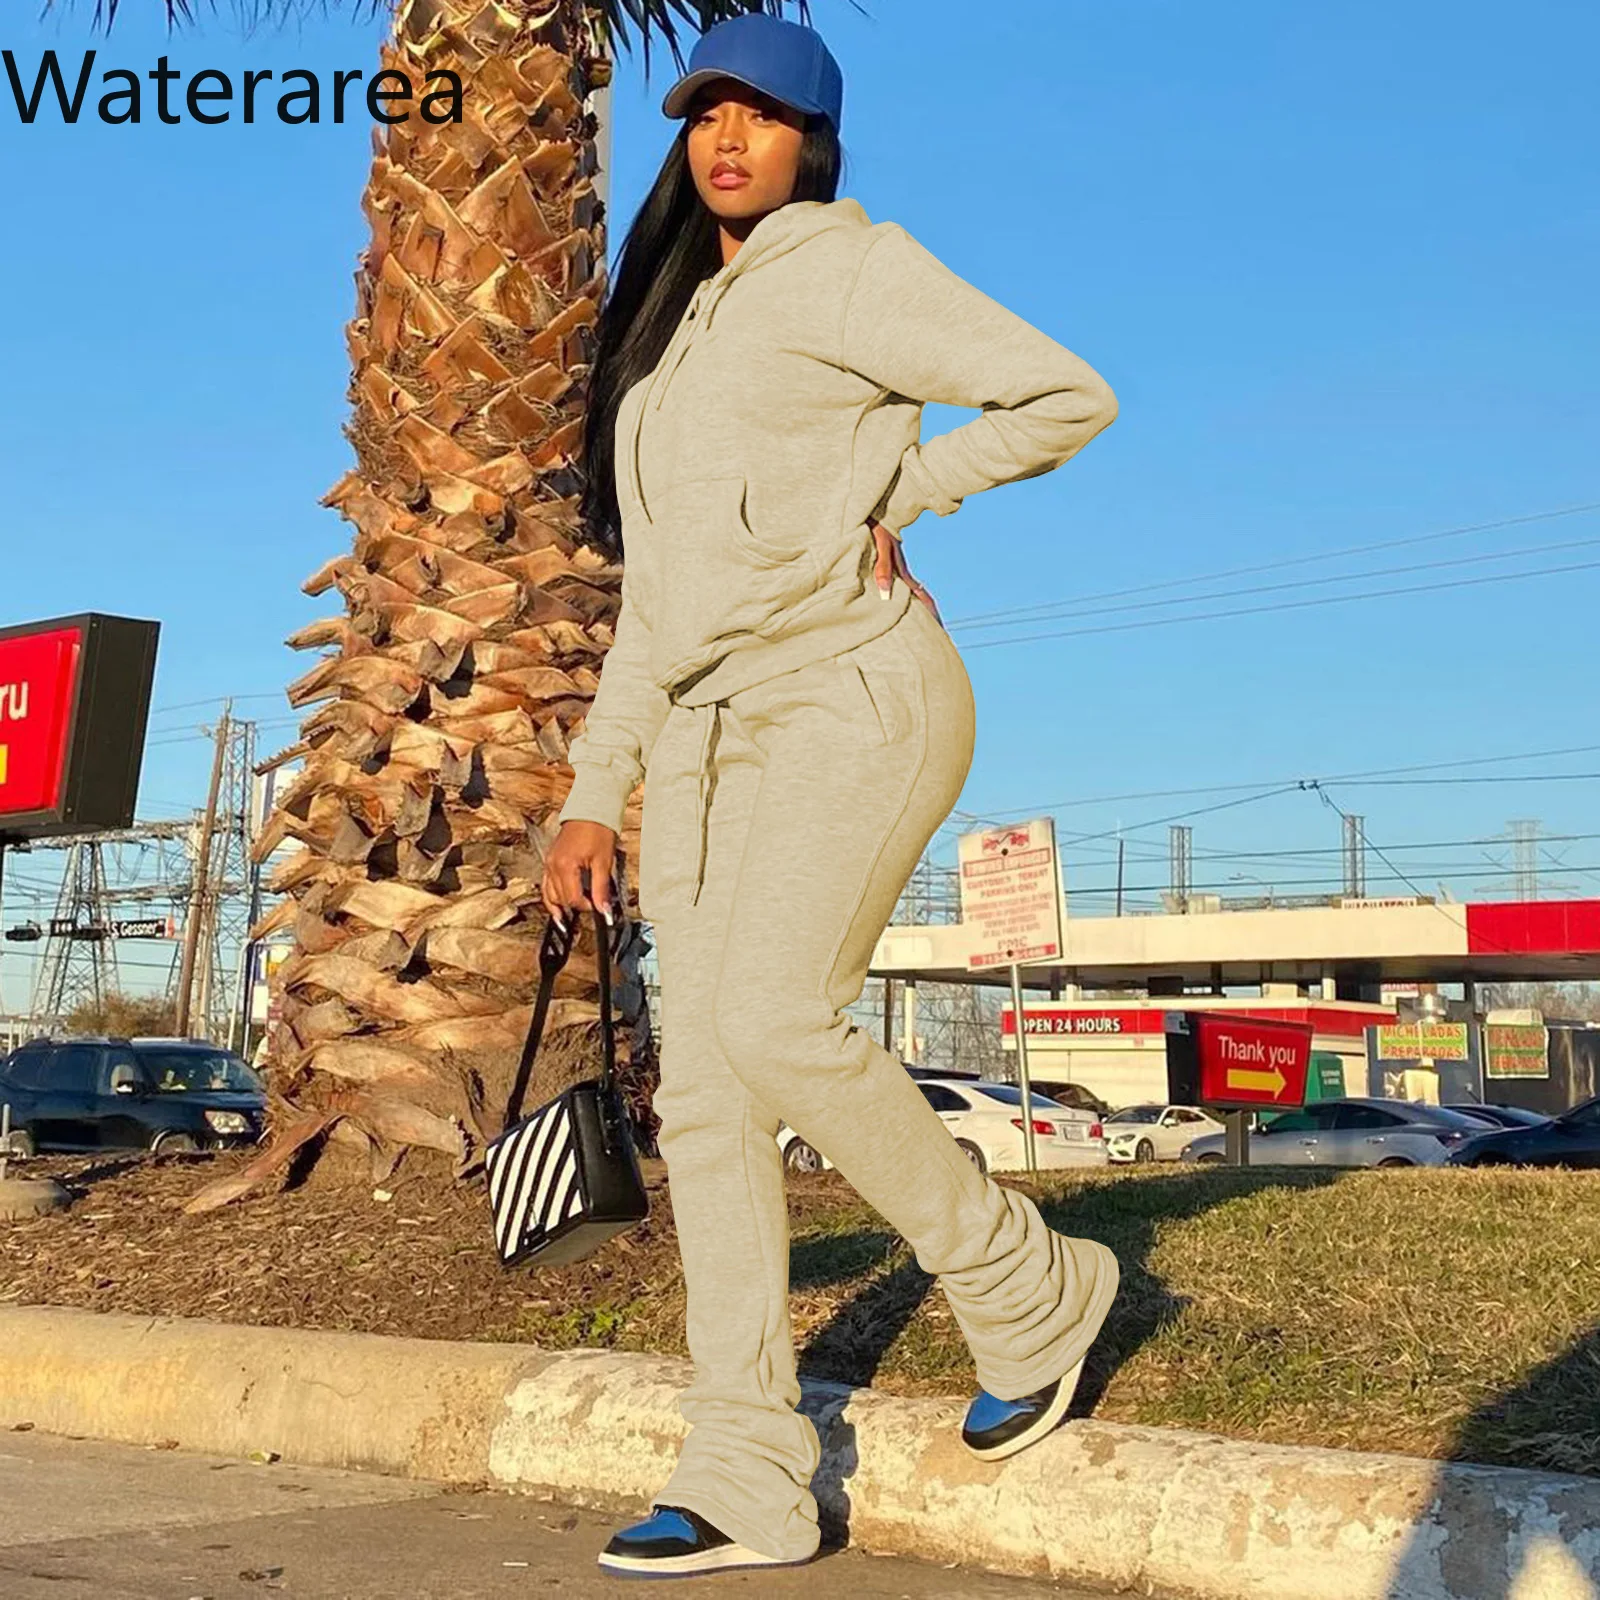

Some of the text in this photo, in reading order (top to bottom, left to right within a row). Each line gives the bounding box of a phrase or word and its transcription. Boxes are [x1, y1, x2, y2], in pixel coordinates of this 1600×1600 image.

[120, 921, 156, 936] Gessner
[1056, 1018, 1072, 1032] 24
[1076, 1017, 1121, 1032] HOURS
[1217, 1035, 1296, 1068] Thank you
